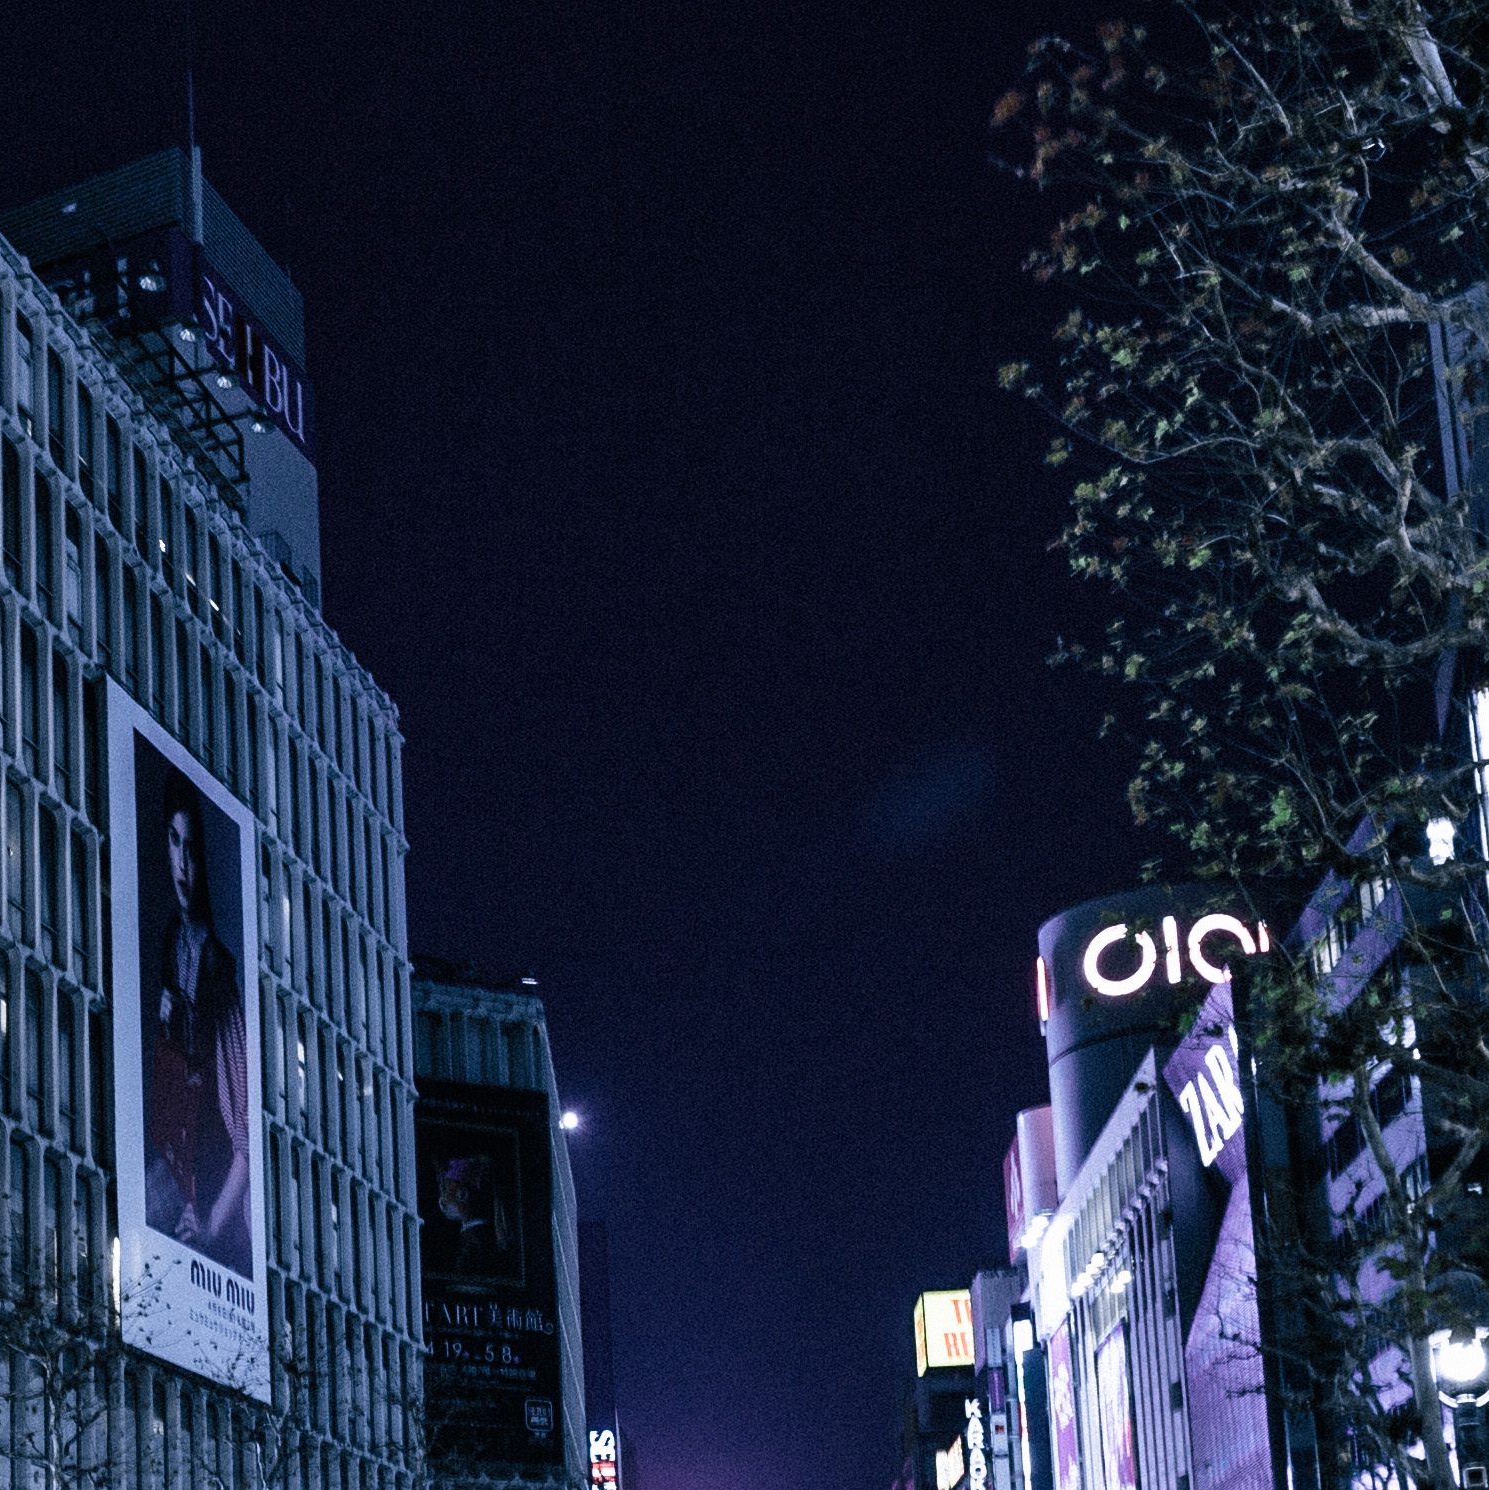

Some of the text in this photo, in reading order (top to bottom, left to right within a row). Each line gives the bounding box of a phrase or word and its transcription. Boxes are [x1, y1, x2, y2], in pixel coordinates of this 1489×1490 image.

[204, 275, 305, 443] SEIBU
[1179, 1022, 1244, 1167] ZAR
[489, 1303, 546, 1332] 美術館
